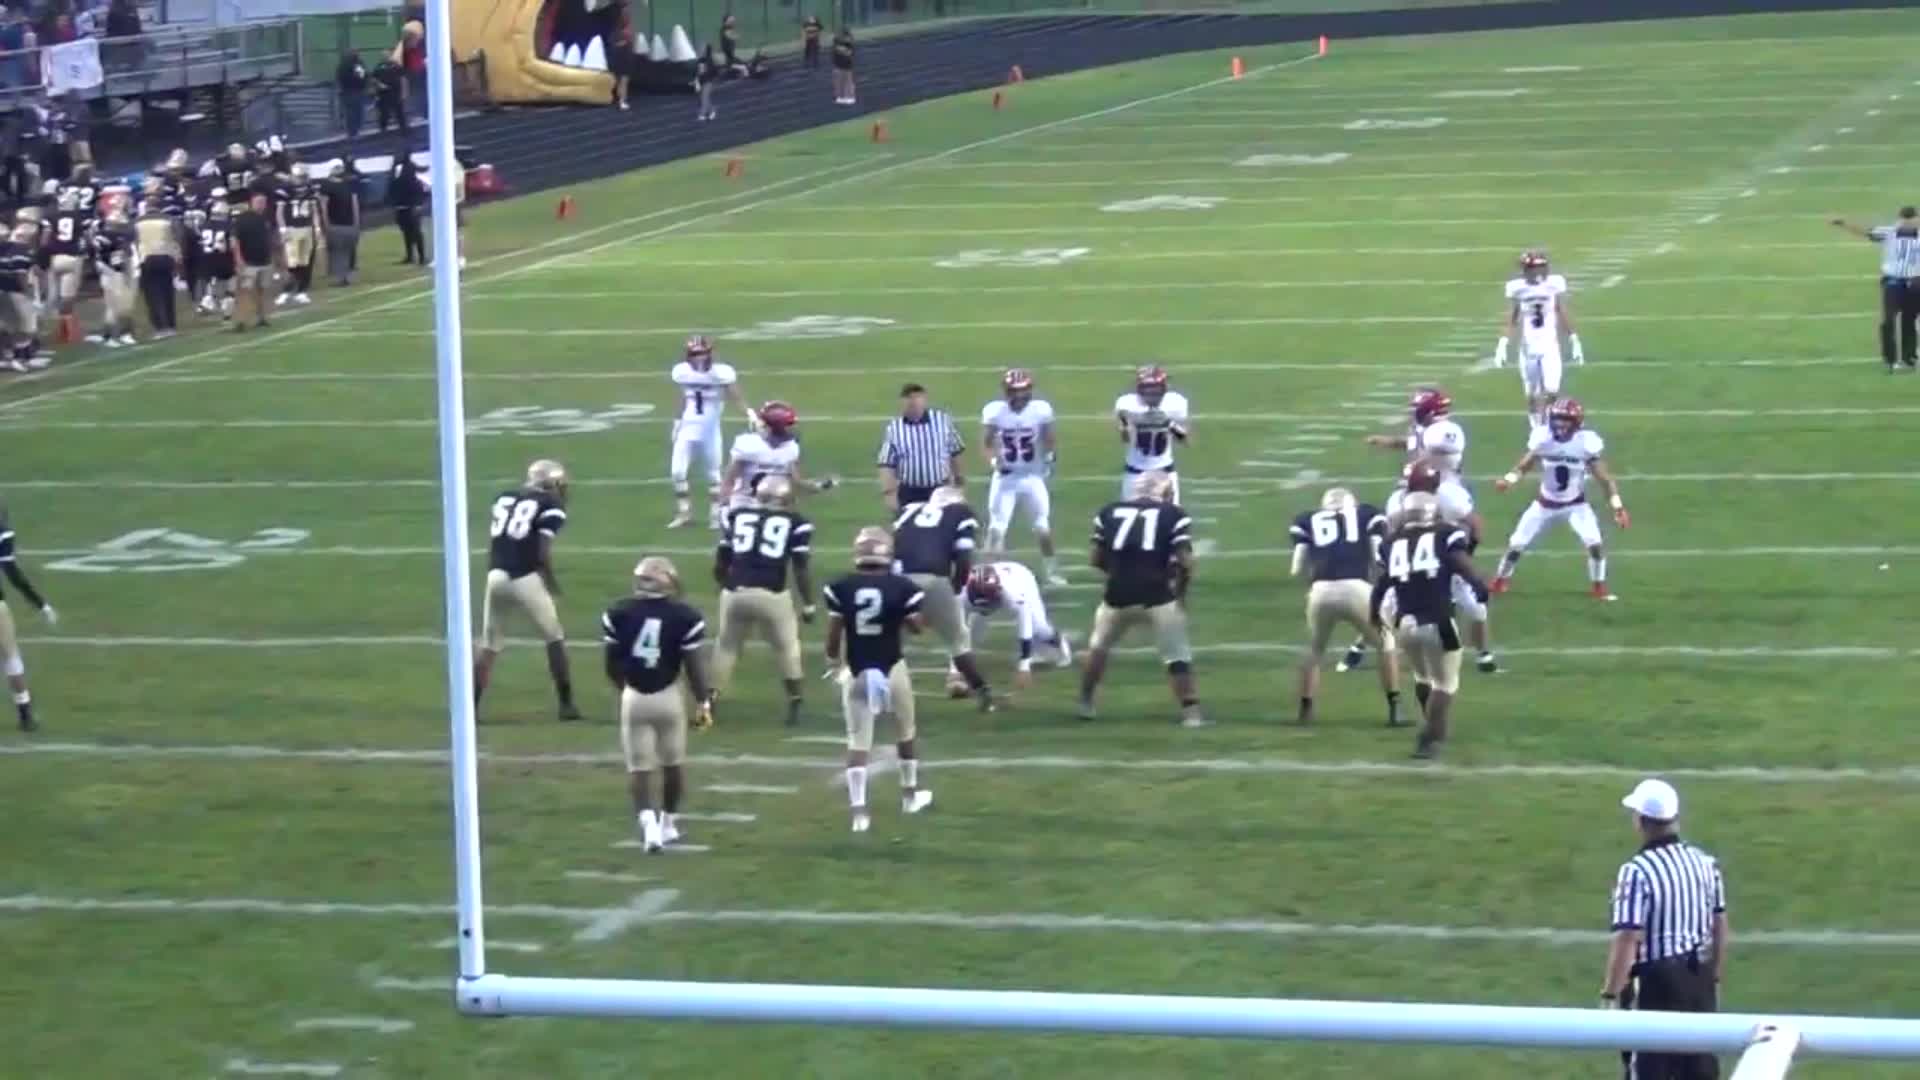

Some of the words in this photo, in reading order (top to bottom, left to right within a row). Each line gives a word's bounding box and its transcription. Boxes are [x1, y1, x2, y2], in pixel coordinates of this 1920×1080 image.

[56, 217, 75, 241] 9
[694, 390, 704, 415] 1
[1002, 434, 1035, 464] 55
[1554, 465, 1570, 492] 9
[490, 496, 538, 539] 58
[733, 512, 791, 559] 59
[1112, 506, 1161, 550] 71
[1311, 505, 1360, 547] 61
[1388, 530, 1441, 582] 44
[854, 586, 884, 636] 2
[631, 617, 663, 669] 4
